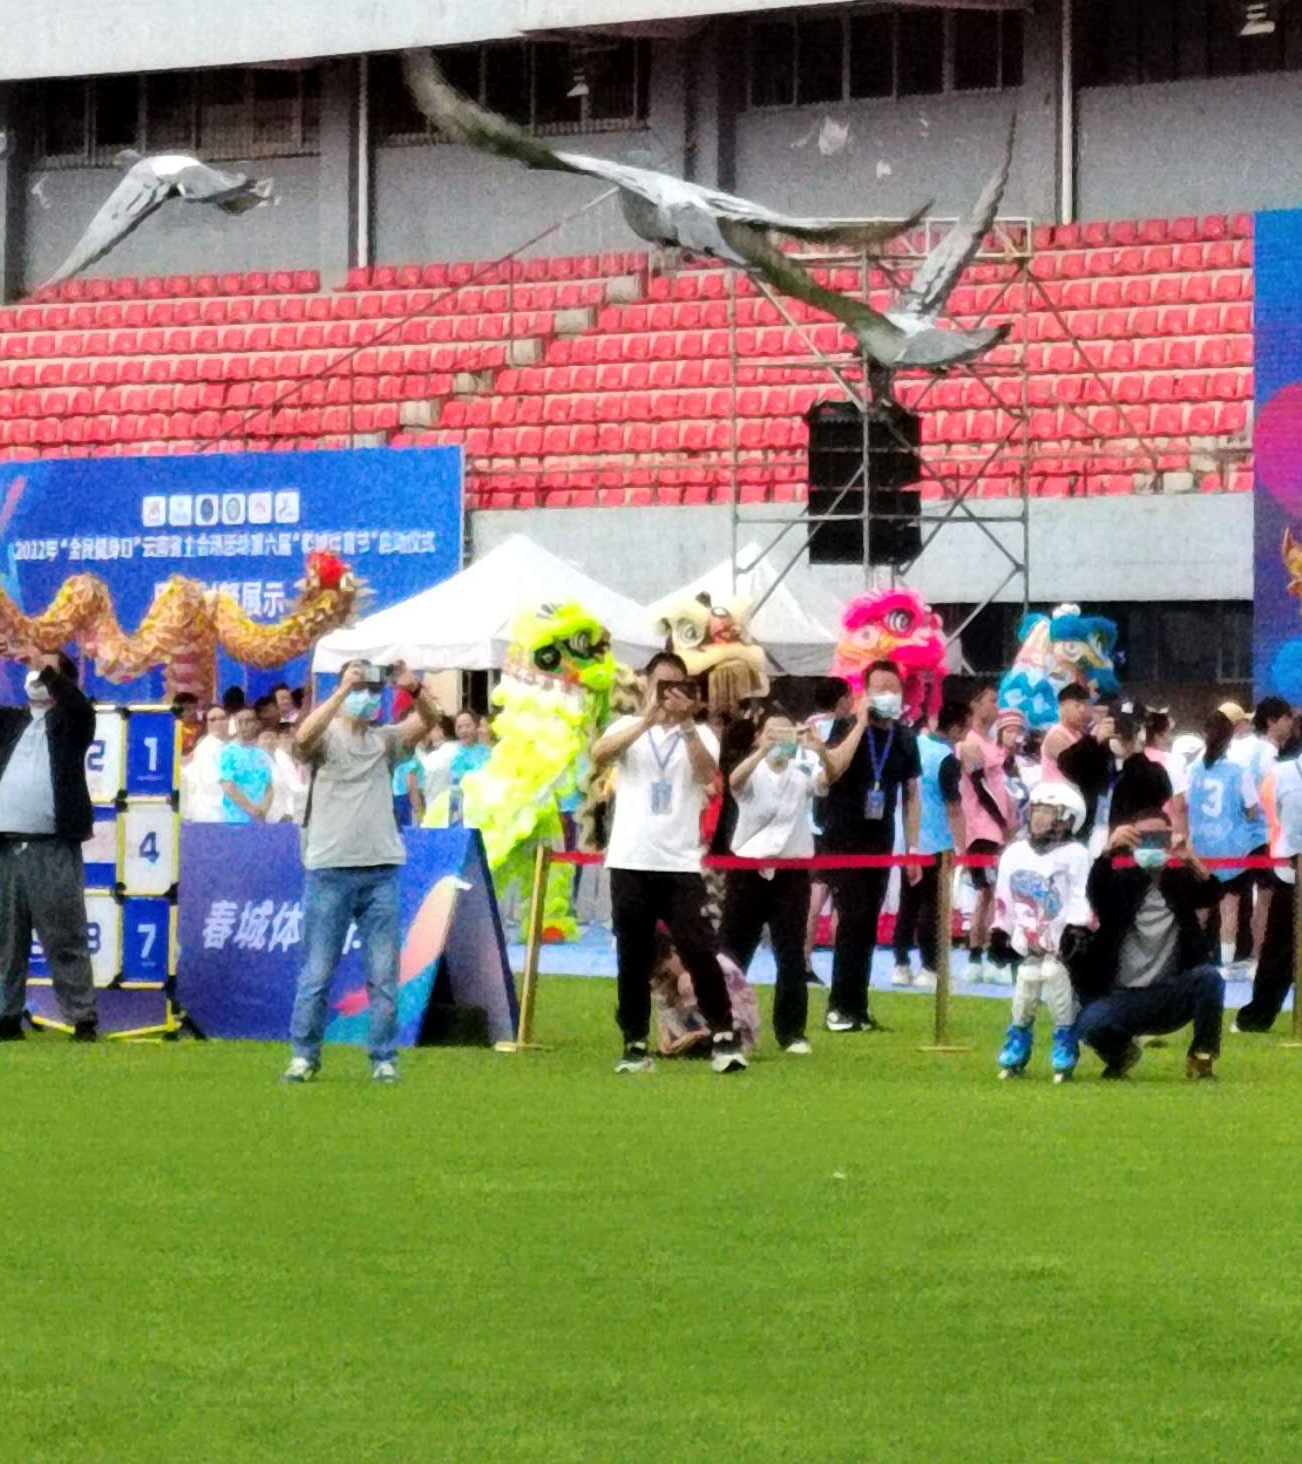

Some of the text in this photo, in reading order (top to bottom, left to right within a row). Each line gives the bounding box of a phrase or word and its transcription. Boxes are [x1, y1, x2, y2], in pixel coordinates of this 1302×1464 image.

[86, 736, 158, 772] 2 1
[1201, 777, 1224, 818] 3
[139, 831, 160, 864] 4
[136, 922, 158, 959] 7
